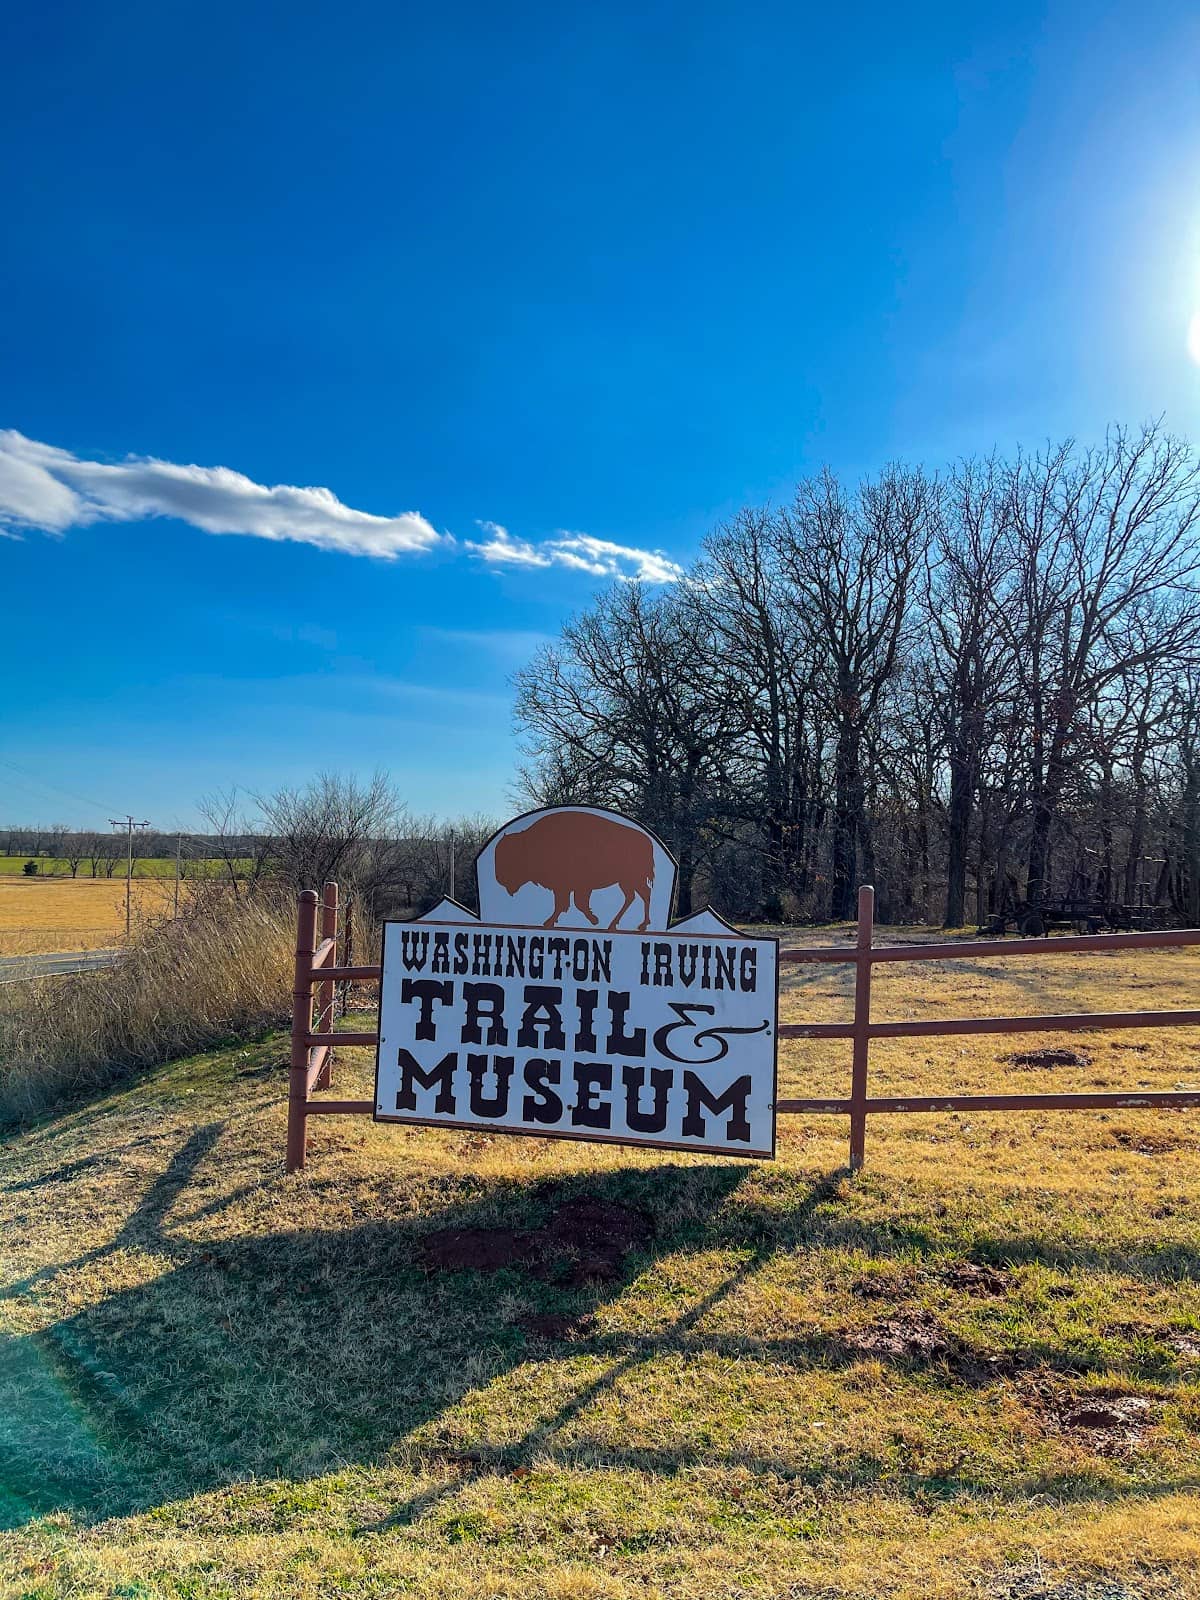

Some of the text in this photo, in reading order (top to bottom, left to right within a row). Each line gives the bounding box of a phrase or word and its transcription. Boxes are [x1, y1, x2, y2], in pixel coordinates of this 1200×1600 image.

[401, 930, 757, 992] WASHINGTON IRVING
[400, 978, 770, 1064] TRAIL &
[396, 1048, 752, 1142] MUSEUM
